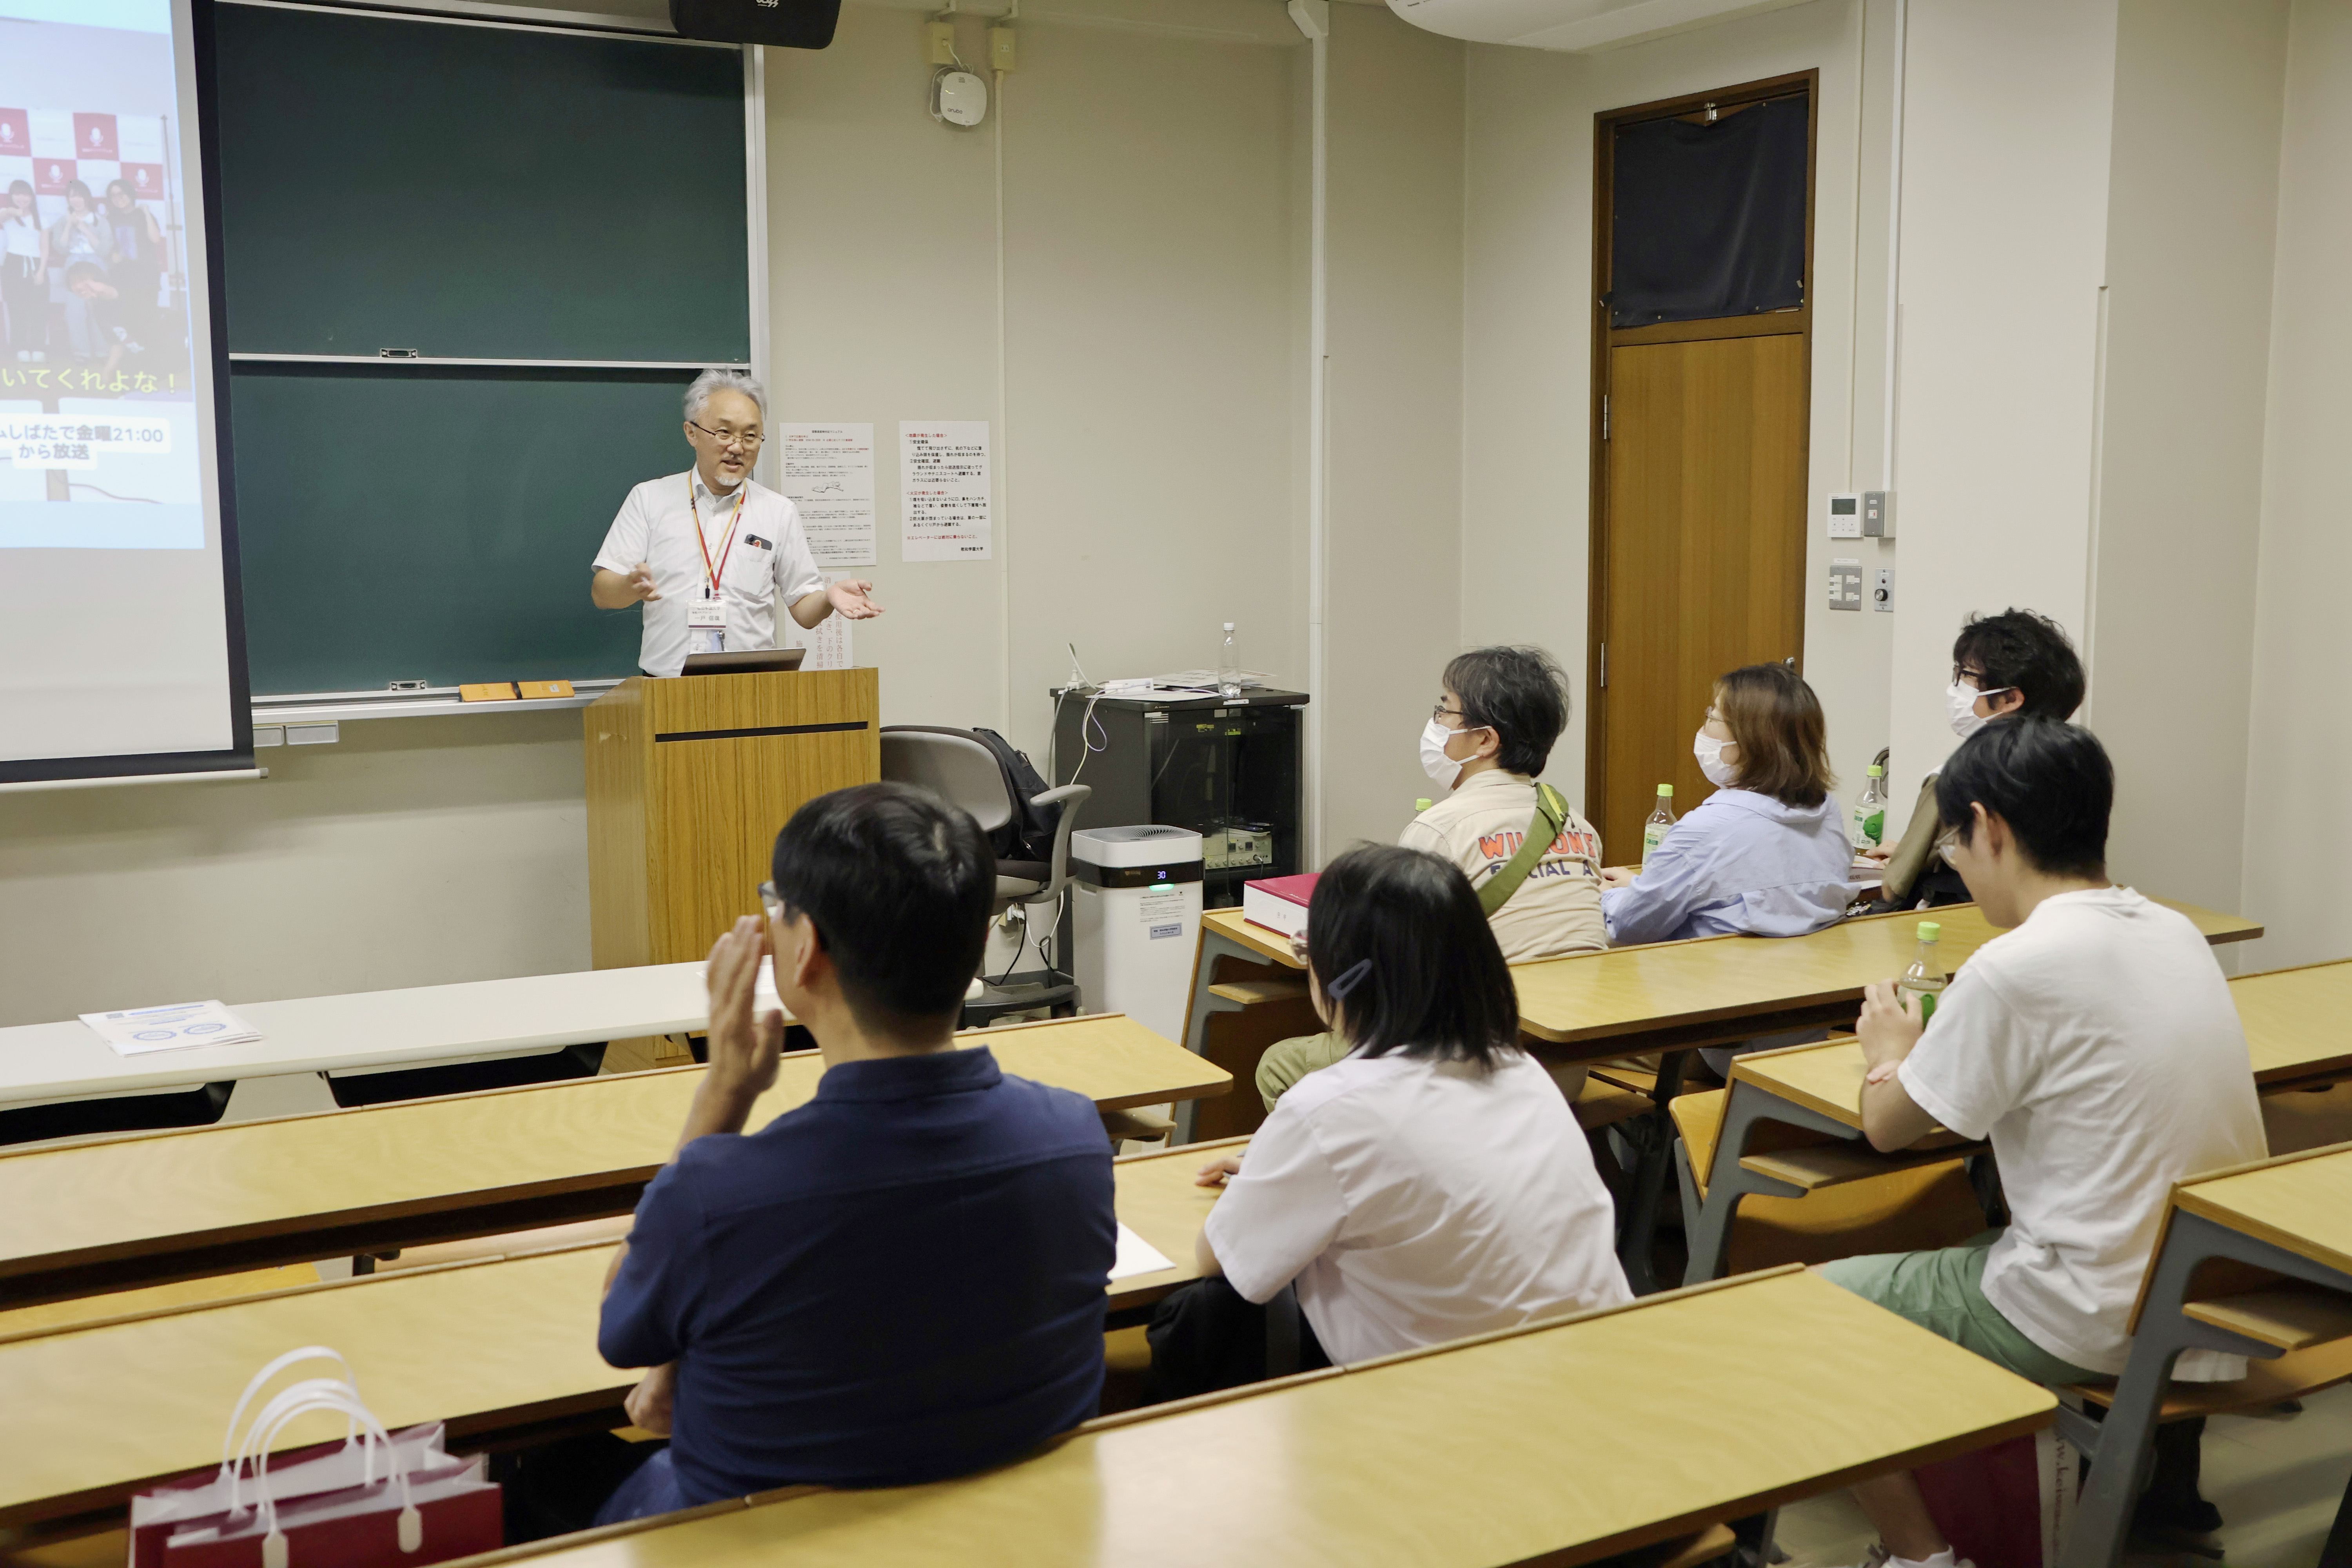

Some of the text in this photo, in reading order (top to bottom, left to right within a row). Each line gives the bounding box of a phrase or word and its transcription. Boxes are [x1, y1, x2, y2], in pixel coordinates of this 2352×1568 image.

[19, 443, 90, 460] から放送
[1479, 828, 1596, 859] WION'S
